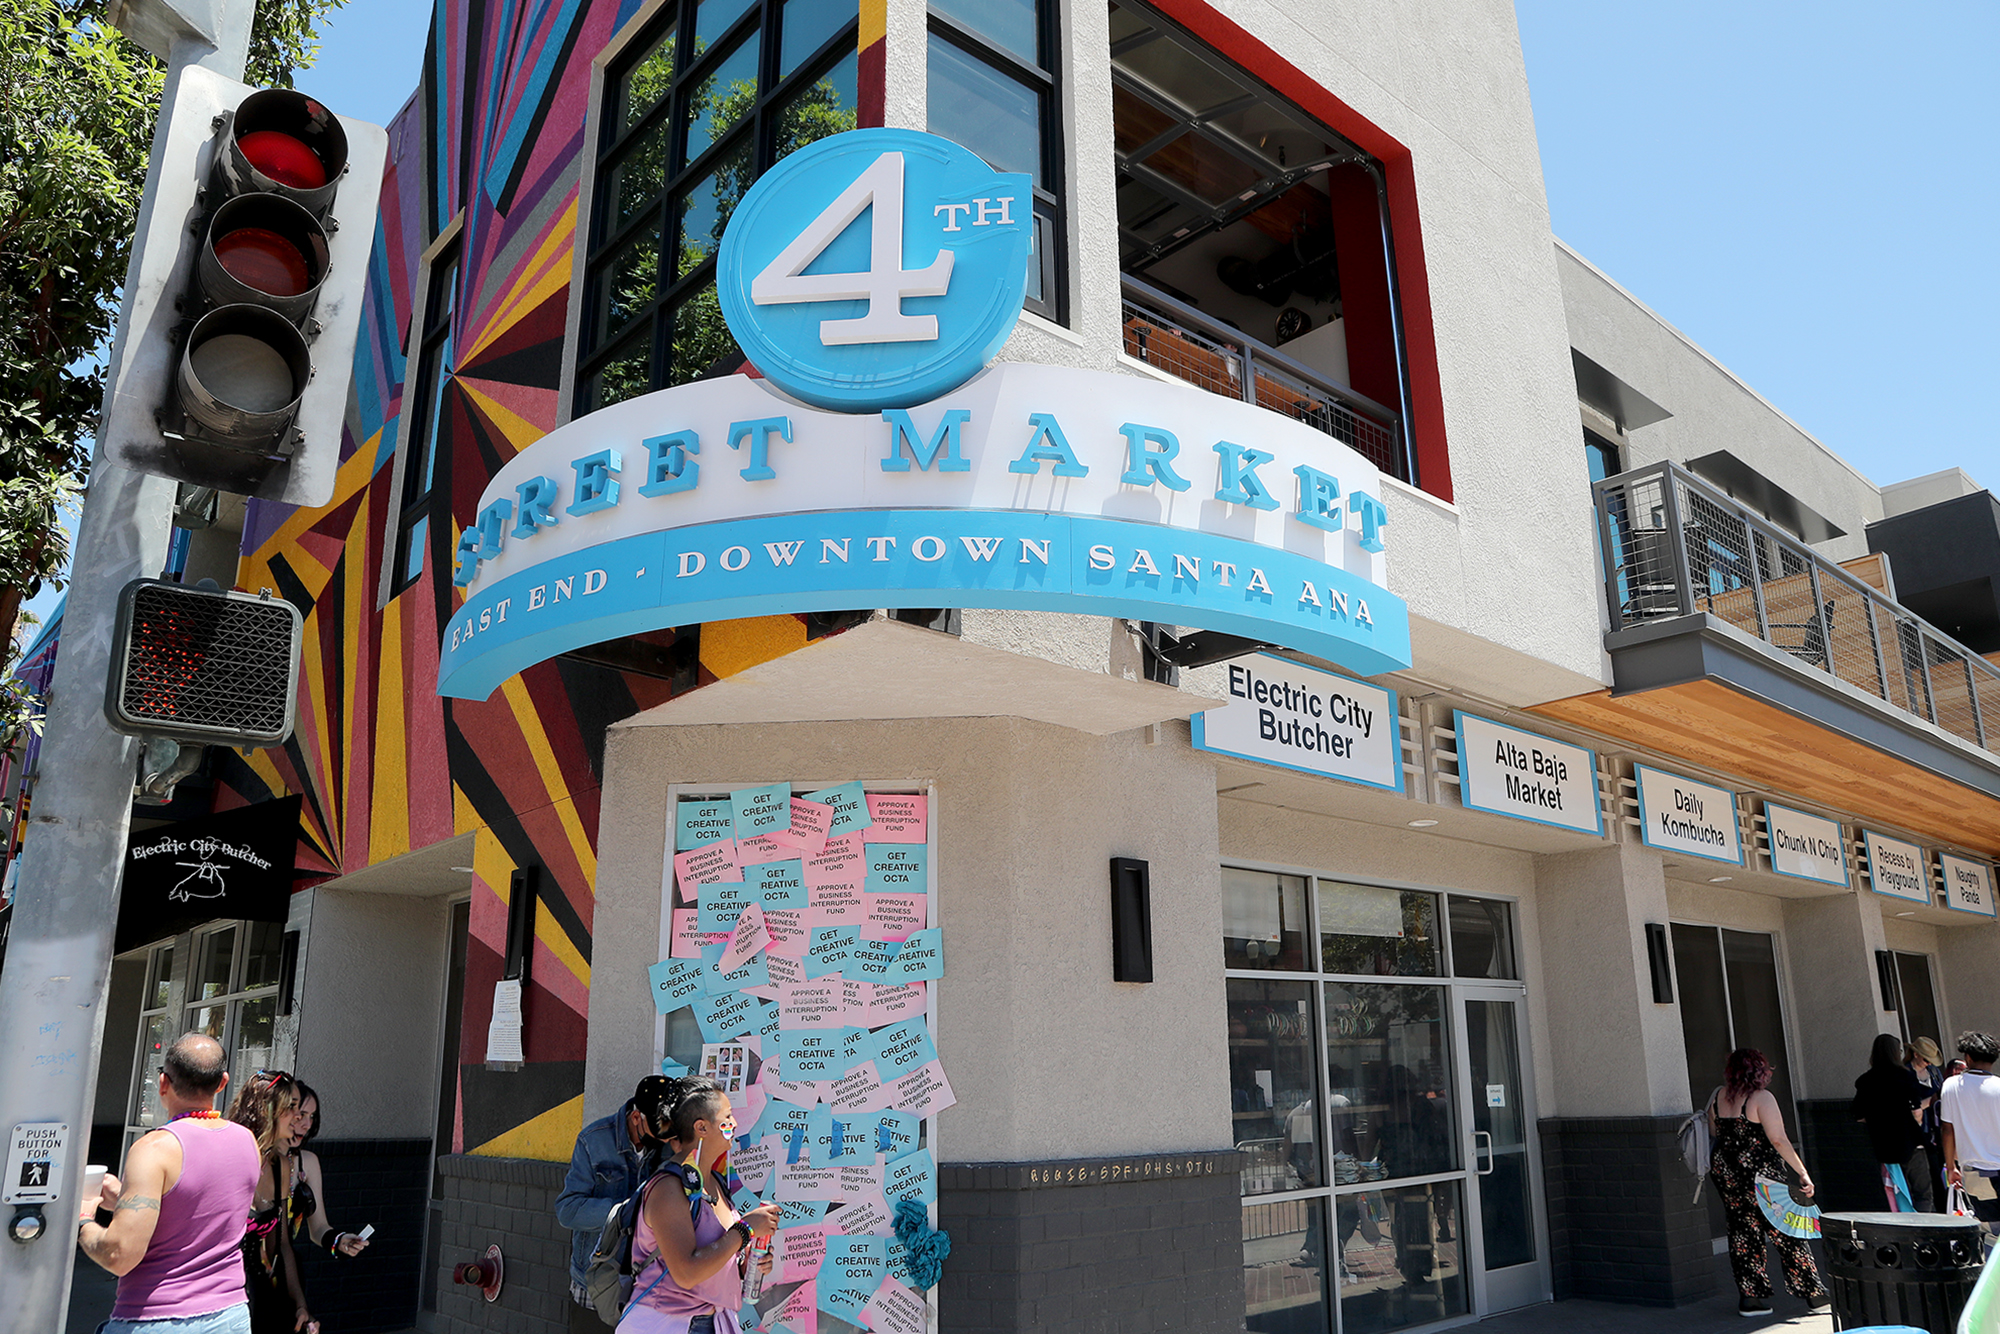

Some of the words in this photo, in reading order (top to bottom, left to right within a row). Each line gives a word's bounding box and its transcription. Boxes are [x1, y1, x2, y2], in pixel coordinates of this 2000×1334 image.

[452, 416, 793, 587] STREET
[880, 408, 1388, 553] MARKET
[450, 598, 511, 652] EAST
[527, 569, 608, 612] END
[676, 536, 1052, 578] DOWNTOWN
[1089, 544, 1273, 595] SANTA
[1298, 580, 1374, 625] ANA
[1229, 664, 1322, 718] Electric
[1330, 693, 1373, 738] City
[1258, 709, 1354, 760] Butcher
[1495, 740, 1527, 772] Alta
[1533, 748, 1568, 783] Baja
[1505, 774, 1563, 811] Market
[753, 794, 771, 804] GET
[825, 794, 842, 805] GET
[1674, 789, 1703, 821] Daily
[699, 809, 718, 817] GET
[742, 803, 783, 817] CREATIVE
[686, 819, 730, 828] CREATIVE
[753, 816, 776, 827] OCTA
[696, 831, 721, 839] OCTA
[787, 828, 806, 838] FUND
[1661, 813, 1726, 848] Kombucha
[132, 836, 186, 860] Electric
[190, 836, 222, 860] City
[221, 844, 271, 870] Butcher
[759, 844, 778, 852] FUND
[1777, 830, 1808, 855] Chunk
[1809, 838, 1817, 856] N
[1818, 841, 1839, 866] Chip
[685, 851, 717, 865] APPROVE
[809, 853, 858, 866] INTERRUPTION
[888, 852, 906, 860] GET
[1878, 845, 1905, 868] Recess
[1905, 853, 1914, 874] by
[689, 857, 723, 872] BUSINESS
[874, 863, 919, 872] CREATIVE
[683, 862, 733, 882] INTERRUPTION
[767, 869, 786, 878] GET
[1880, 866, 1919, 890] Playground
[1955, 866, 1980, 889] Naughty
[883, 875, 909, 883] OCTA
[720, 891, 738, 899] GET
[764, 891, 789, 900] OCTA
[1960, 886, 1980, 905] Panda
[707, 902, 751, 910] CREATIVE
[810, 899, 860, 907] INTERRUPTION
[869, 915, 919, 923] INTERRUPTION
[820, 929, 838, 941] GET
[736, 941, 753, 955] FUND
[809, 937, 854, 956] CREATIVE
[869, 941, 888, 950] GET
[904, 939, 921, 949] GET
[822, 951, 847, 964] OCTA
[668, 963, 685, 975] GET
[862, 963, 887, 973] OCTA
[903, 962, 927, 972] OCTA
[660, 968, 702, 991] CREATIVE
[723, 970, 750, 981] OCTA
[672, 983, 697, 998] OCTA
[715, 994, 733, 1008] GET
[793, 997, 829, 1005] BUSINESS
[886, 1002, 906, 1011] FUND
[706, 999, 750, 1024] CREATIVE
[785, 1005, 838, 1013] INTERRUPTION
[720, 1015, 745, 1030] OCTA
[889, 1029, 908, 1042] GET
[802, 1038, 821, 1046] GET
[881, 1034, 922, 1059] CREATIVE
[789, 1049, 835, 1059] CREATIVE
[895, 1050, 919, 1066] OCTA
[799, 1062, 825, 1070] OCTA
[779, 1081, 798, 1091] FUND
[830, 1073, 859, 1090] APPROVE
[897, 1071, 925, 1090] APPROVE
[835, 1078, 869, 1096] BUSINESS
[902, 1077, 932, 1097] BUSINESS
[830, 1082, 880, 1108] INTERRUPTION
[897, 1082, 943, 1109] INTERRUPTION
[848, 1096, 868, 1109] FUND
[915, 1096, 932, 1110] FUND
[788, 1111, 808, 1119] GET
[880, 1117, 900, 1128] GET
[27, 1130, 56, 1138] PUSH
[18, 1139, 61, 1149] BUTTON
[28, 1150, 49, 1158] FOR
[734, 1153, 769, 1165] BUSINESS
[744, 1172, 764, 1180] FUND
[893, 1165, 912, 1179] GET
[885, 1171, 929, 1196] CREATIVE
[900, 1188, 923, 1202] OCTA
[841, 1211, 874, 1231] BUSINESS
[784, 1233, 817, 1243] APPROVE
[787, 1240, 823, 1252] BUSINESS
[849, 1244, 869, 1253] GET
[888, 1244, 907, 1255] GET
[798, 1259, 818, 1267] FUND
[835, 1257, 880, 1266] CREATIVE
[846, 1269, 873, 1278] OCTA
[891, 1290, 920, 1314] APPROVE
[887, 1298, 919, 1324] BUSINESS
[884, 1318, 903, 1333] FUND
